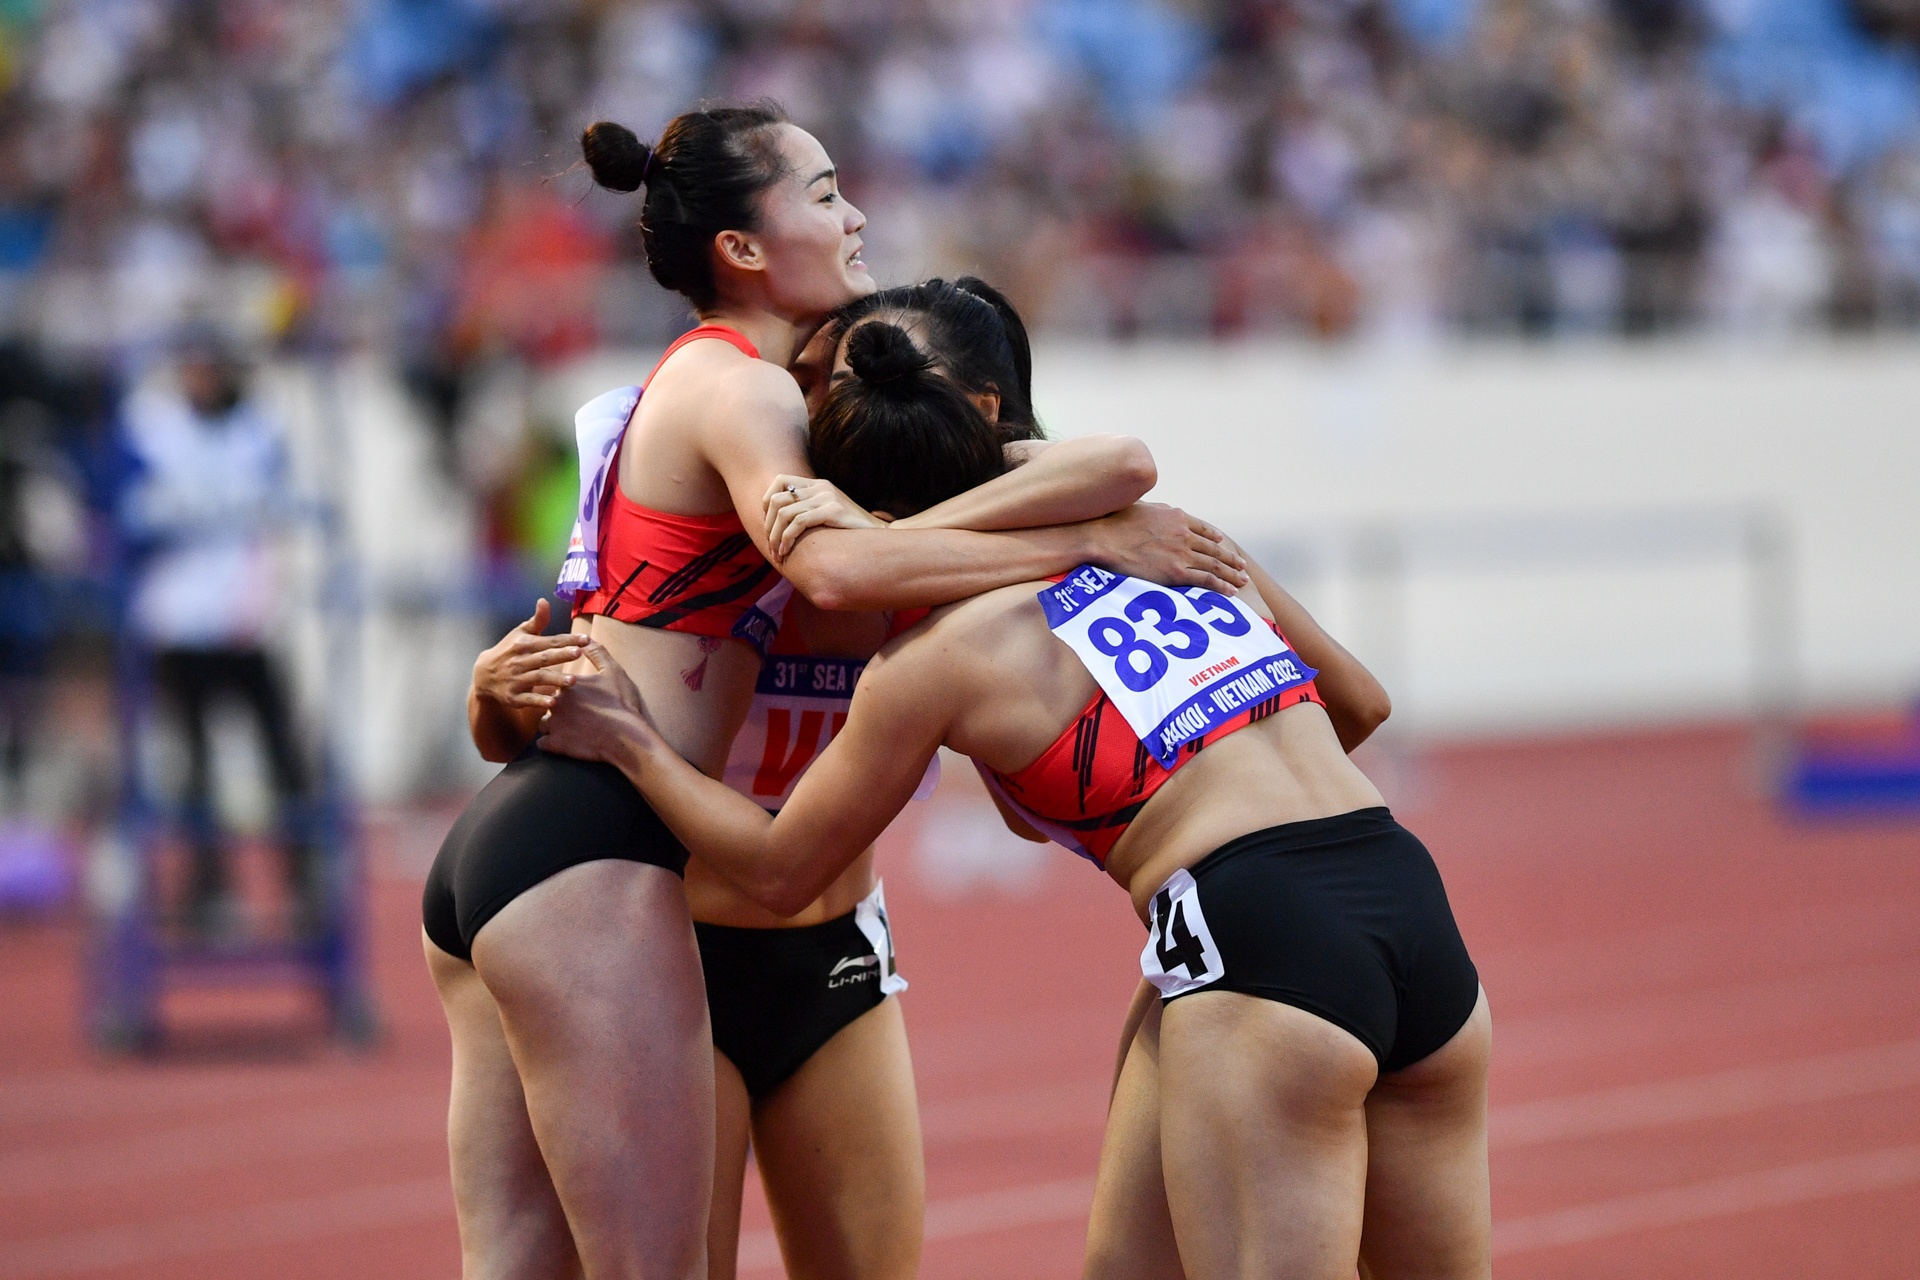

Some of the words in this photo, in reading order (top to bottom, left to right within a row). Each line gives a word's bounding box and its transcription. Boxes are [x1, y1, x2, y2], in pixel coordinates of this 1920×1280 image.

[1072, 566, 1116, 595] SEA
[1087, 589, 1251, 692] 835
[812, 664, 847, 691] SEA
[1188, 656, 1240, 687] VIETNAM
[1159, 702, 1211, 753] HANOI
[1209, 668, 1275, 713] VIETNAM
[1265, 658, 1302, 685] 2022
[1155, 887, 1209, 980] 4
[828, 969, 880, 989] LI-NIN
